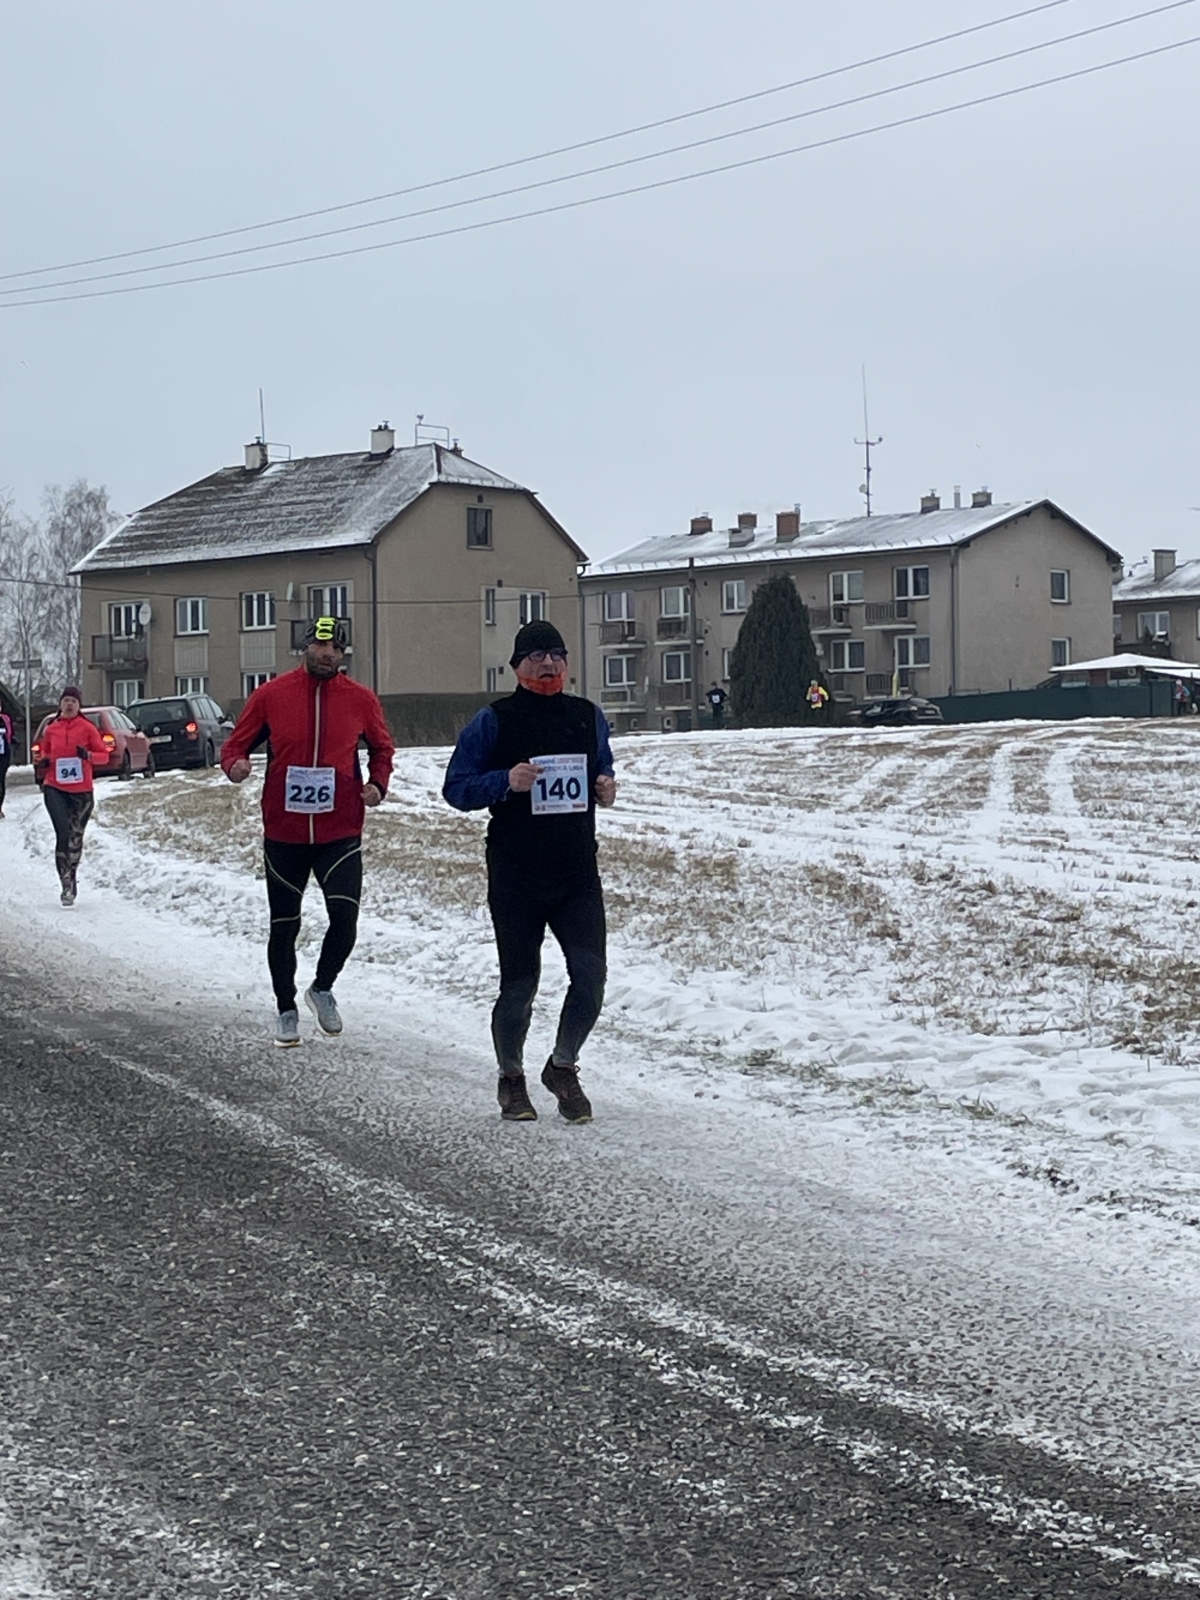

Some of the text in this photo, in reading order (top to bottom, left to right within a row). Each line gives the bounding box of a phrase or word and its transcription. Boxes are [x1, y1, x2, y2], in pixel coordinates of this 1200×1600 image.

[60, 767, 77, 779] 94
[289, 784, 331, 804] 226
[536, 776, 582, 801] 140
